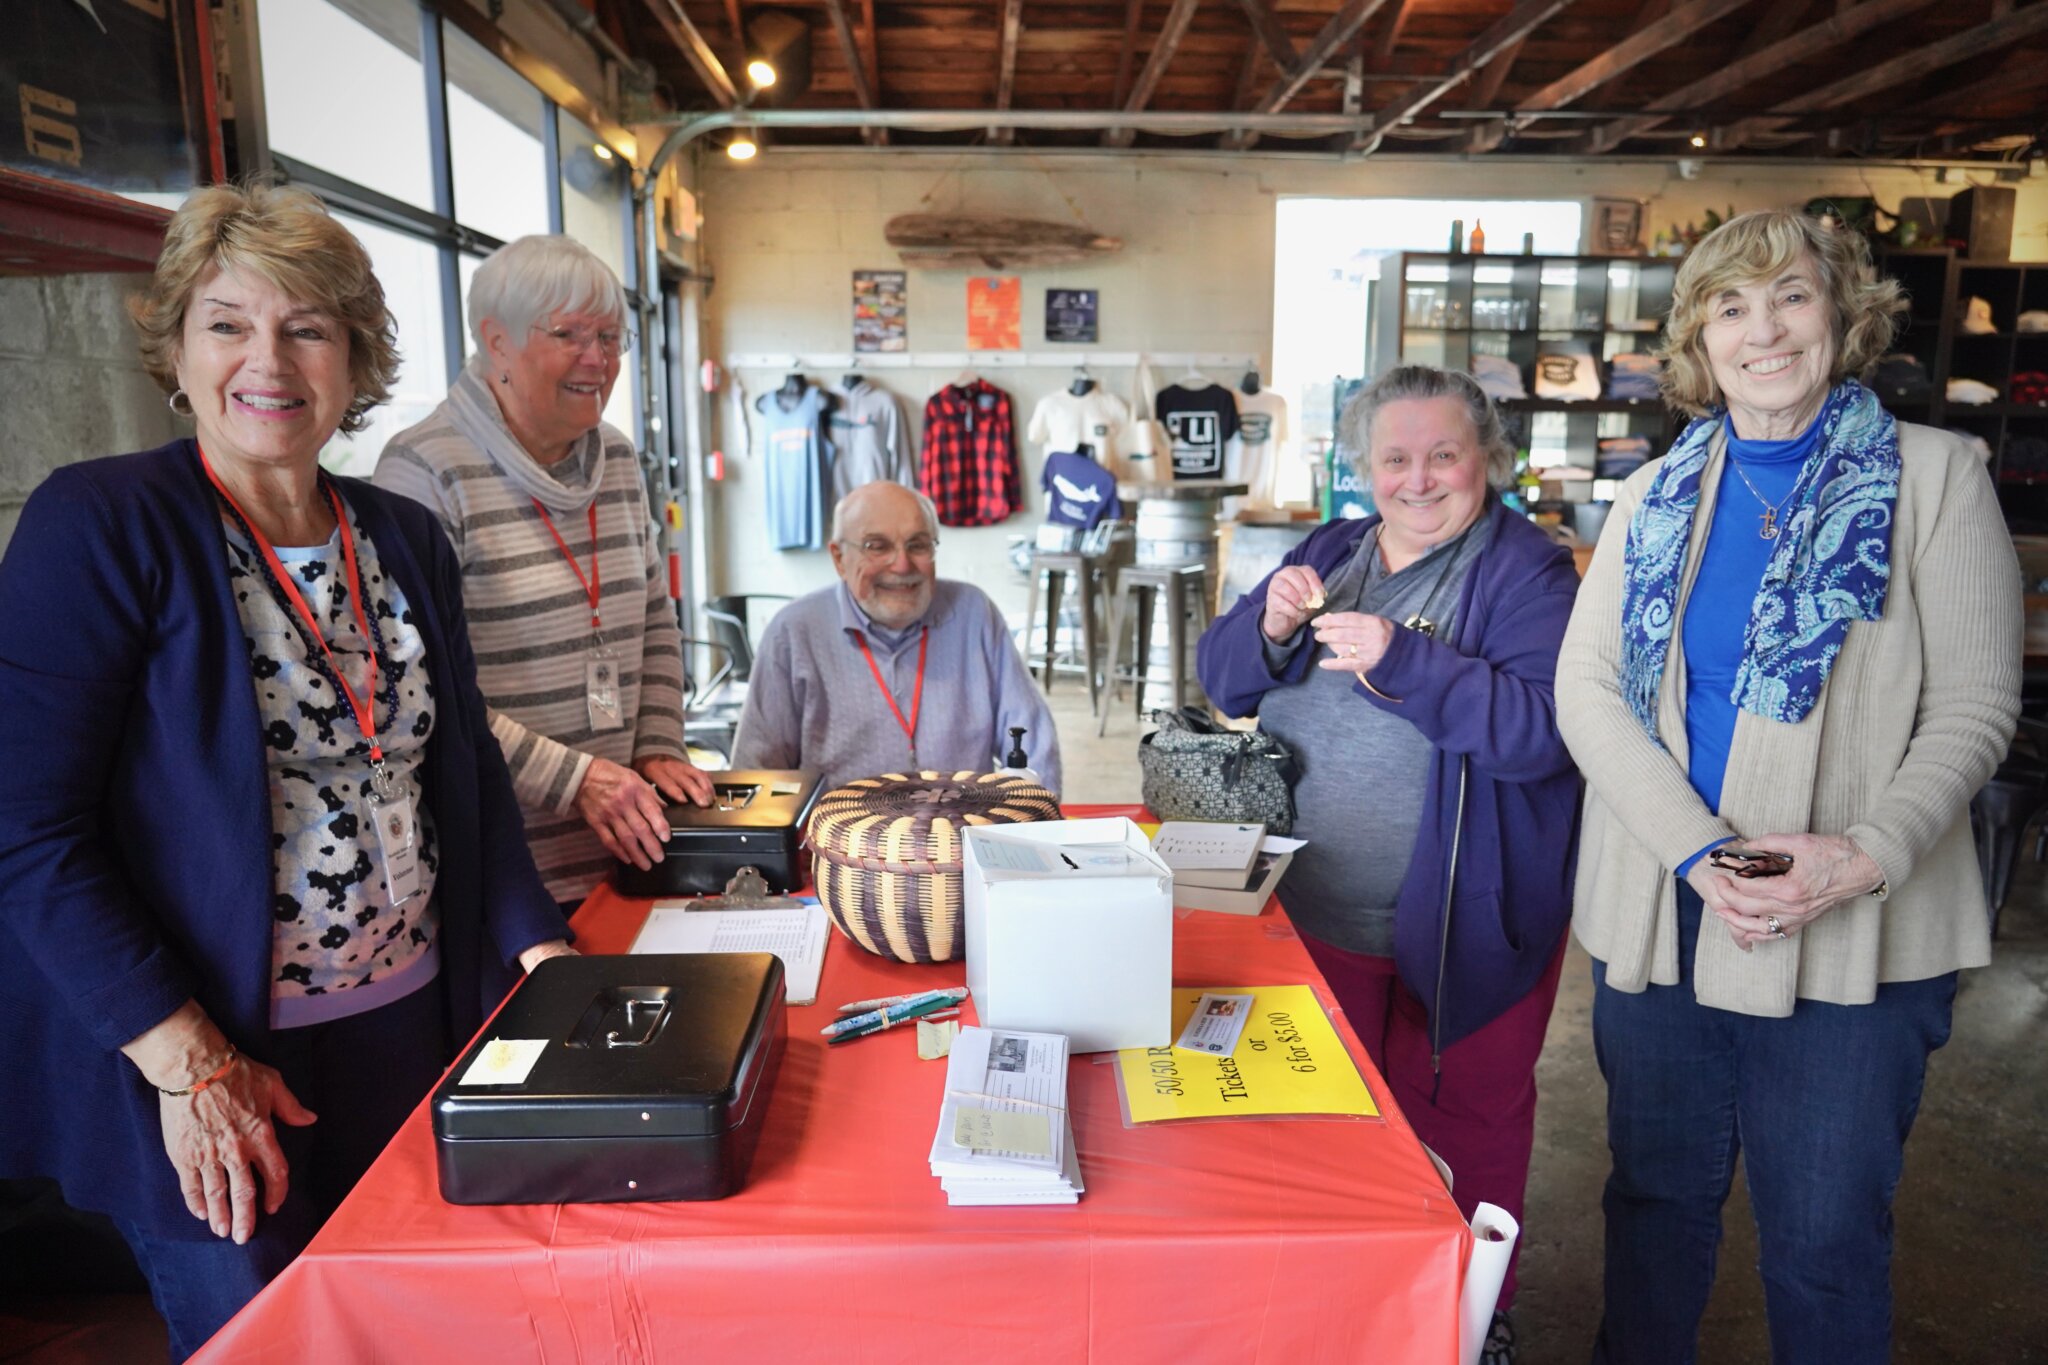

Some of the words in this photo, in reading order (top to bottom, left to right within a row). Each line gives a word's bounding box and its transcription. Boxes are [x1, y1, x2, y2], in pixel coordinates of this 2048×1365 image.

[861, 1025, 883, 1036] WAGNE
[1267, 1012, 1303, 1042] $5.00
[1249, 1038, 1267, 1051] or
[1286, 1045, 1312, 1062] for
[1150, 1060, 1184, 1096] 50/50
[1216, 1057, 1249, 1102] Tickets
